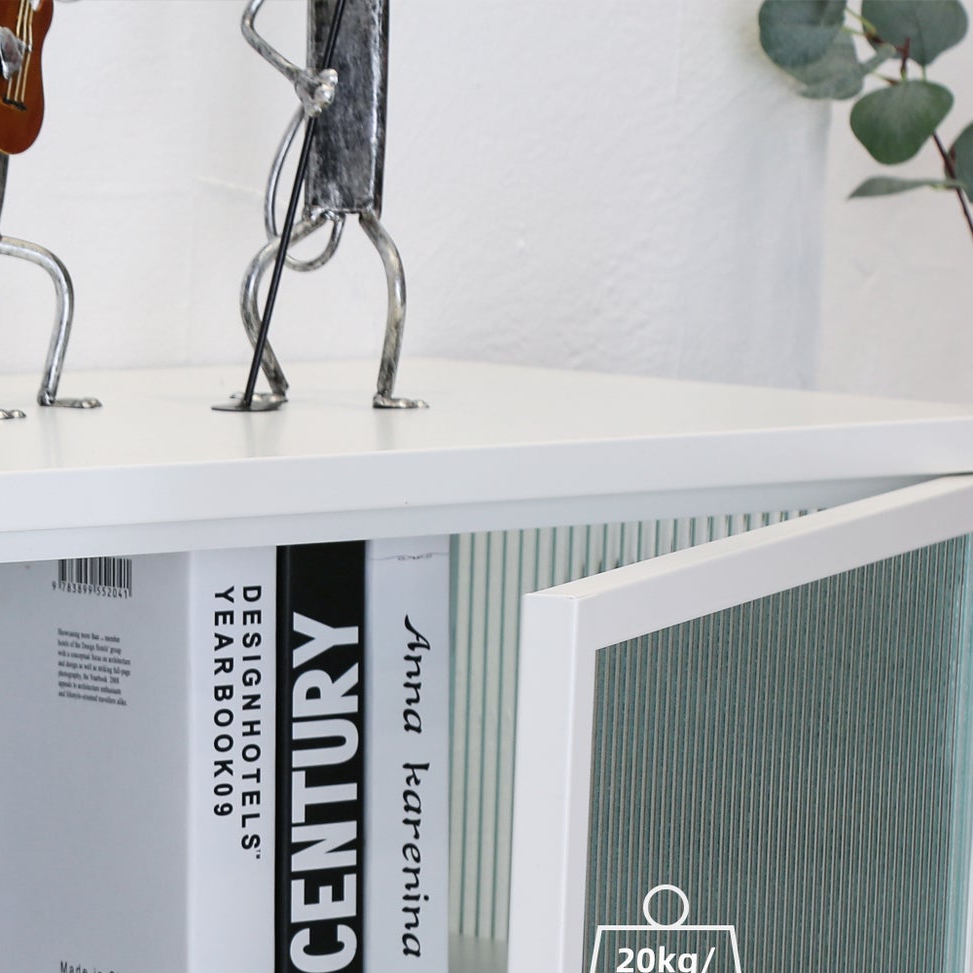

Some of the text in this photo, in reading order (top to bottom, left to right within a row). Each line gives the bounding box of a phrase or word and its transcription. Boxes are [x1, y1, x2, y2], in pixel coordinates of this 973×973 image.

[214, 585, 234, 816] YEARBOOK09
[290, 612, 359, 973] CENTURY
[402, 614, 431, 958] Anna karenina
